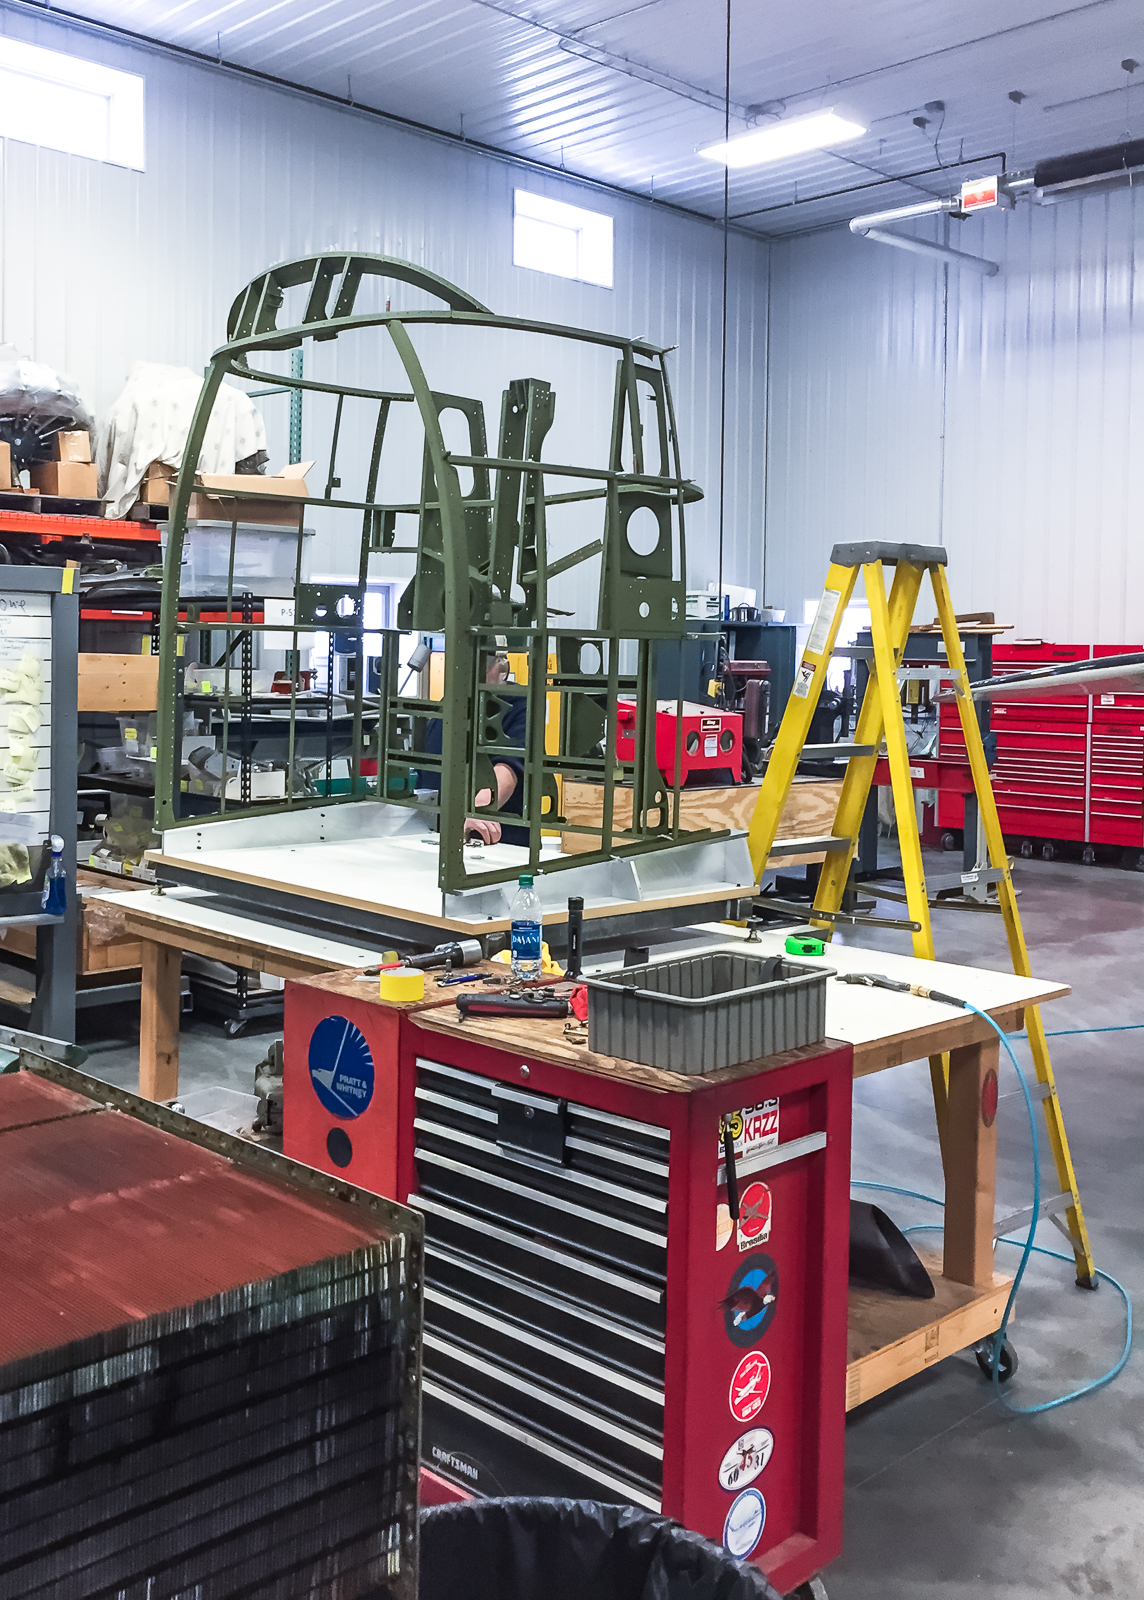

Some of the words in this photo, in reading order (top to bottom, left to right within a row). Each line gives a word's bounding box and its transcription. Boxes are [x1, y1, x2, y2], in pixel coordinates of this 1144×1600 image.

[512, 935, 540, 946] DASANI
[339, 1074, 361, 1087] PRATT
[361, 1080, 368, 1089] &
[336, 1082, 367, 1099] WHITNEY
[744, 1109, 778, 1143] KAZZ
[432, 1446, 479, 1480] CRAFTSMAN
